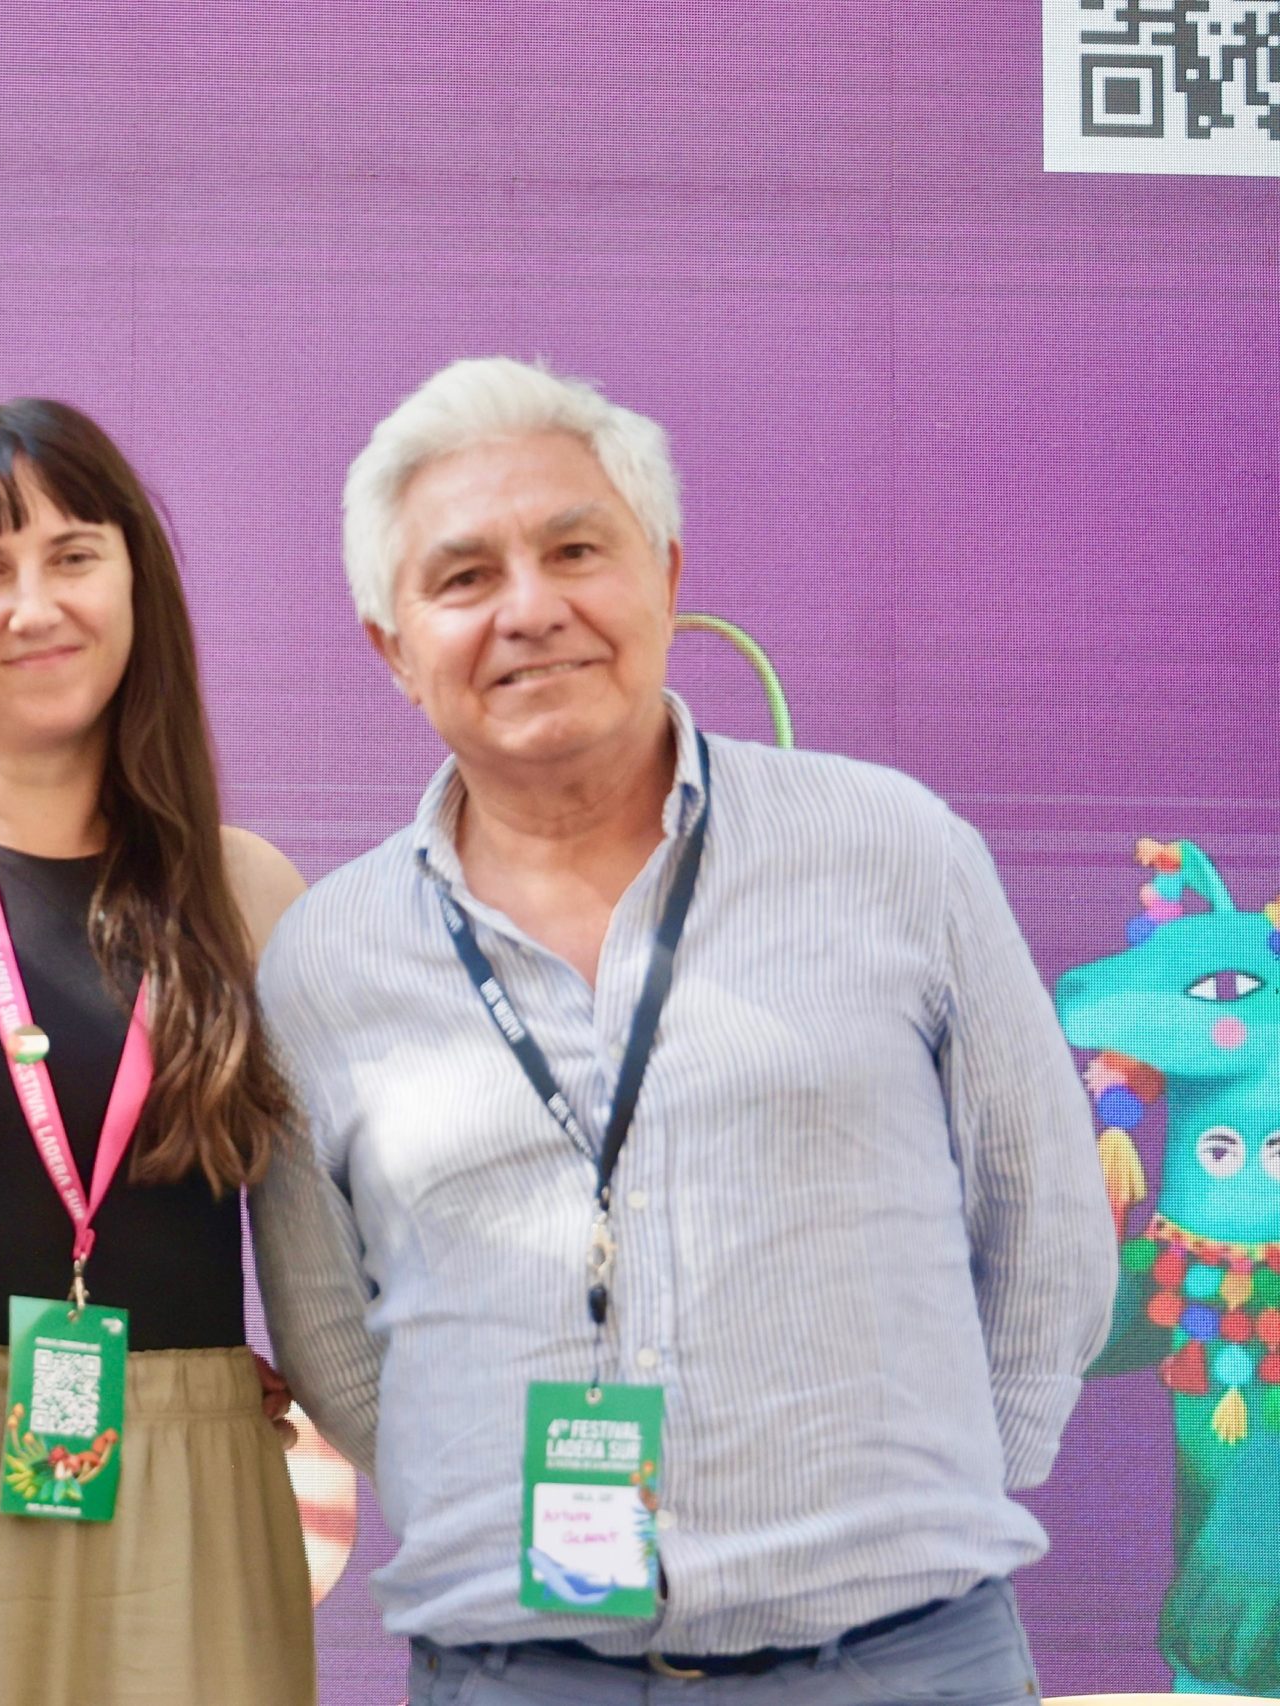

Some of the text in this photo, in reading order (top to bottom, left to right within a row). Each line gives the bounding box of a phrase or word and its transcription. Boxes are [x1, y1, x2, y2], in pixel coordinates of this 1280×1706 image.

[15, 1061, 86, 1222] ESTIVAL LADERA SUR
[570, 1419, 643, 1440] FESTIVAL
[546, 1438, 641, 1460] LADERA SUR
